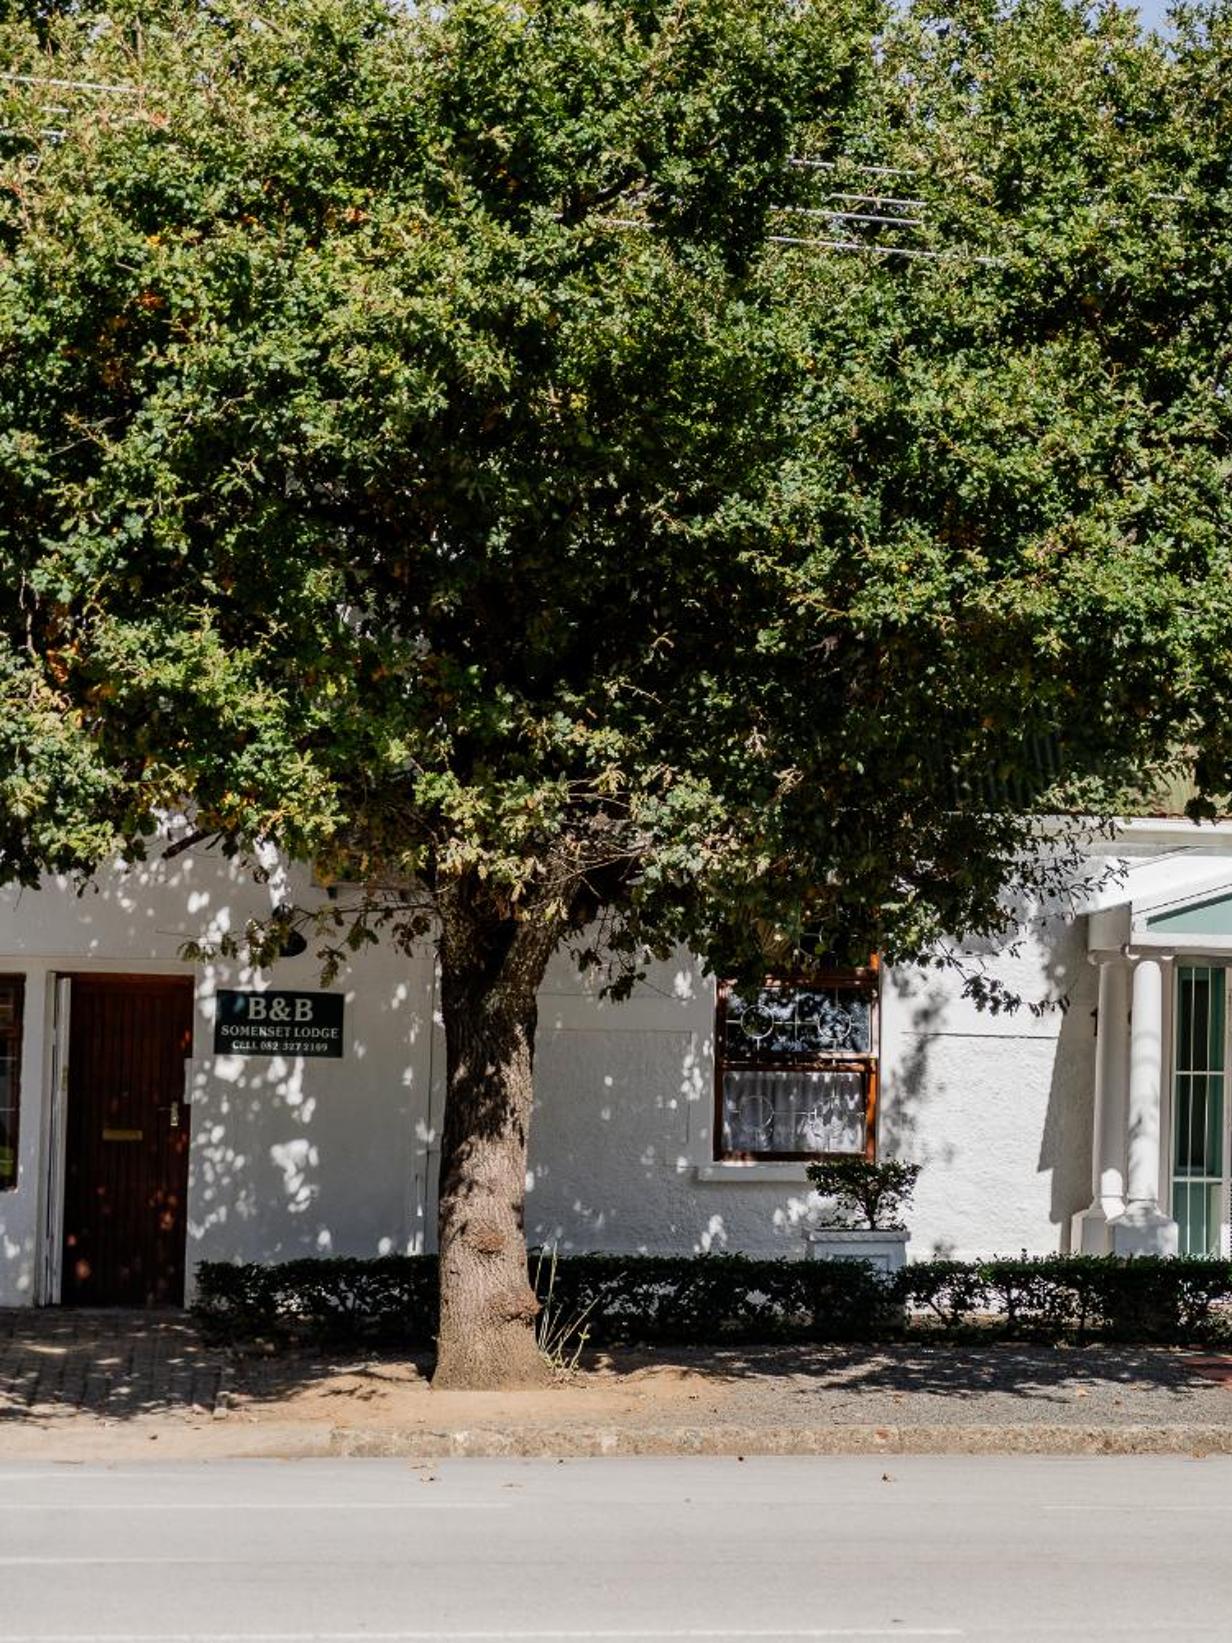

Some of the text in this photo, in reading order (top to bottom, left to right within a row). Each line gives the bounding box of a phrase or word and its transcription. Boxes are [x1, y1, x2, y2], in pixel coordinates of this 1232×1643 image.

[248, 997, 313, 1021] B&B
[221, 1025, 340, 1039] SOMERSET LODGE
[282, 1042, 301, 1051] 327
